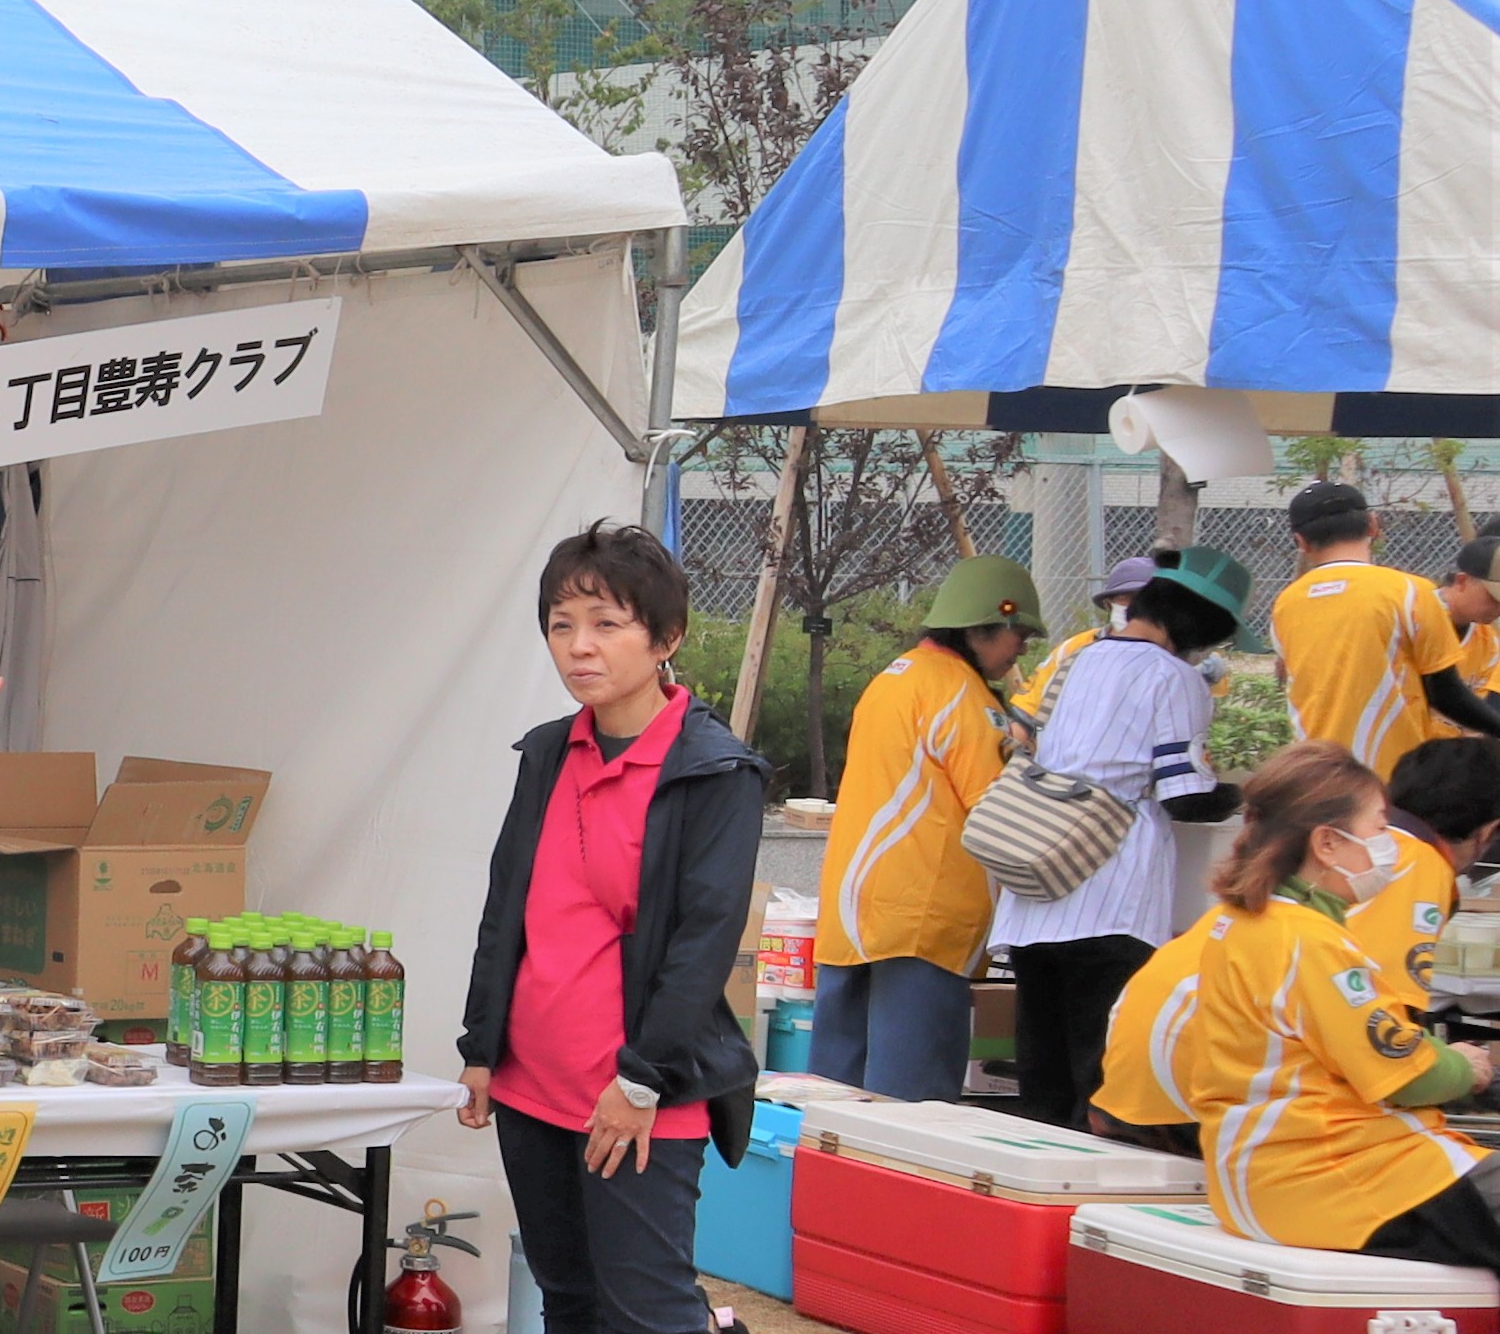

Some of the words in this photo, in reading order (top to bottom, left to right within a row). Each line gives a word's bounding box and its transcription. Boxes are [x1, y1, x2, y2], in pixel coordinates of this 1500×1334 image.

[141, 963, 158, 981] M
[205, 984, 231, 1011] 茶
[250, 983, 270, 1010] 茶
[288, 982, 314, 1010] 茶
[329, 982, 352, 1009] 茶
[369, 982, 392, 1009] 茶
